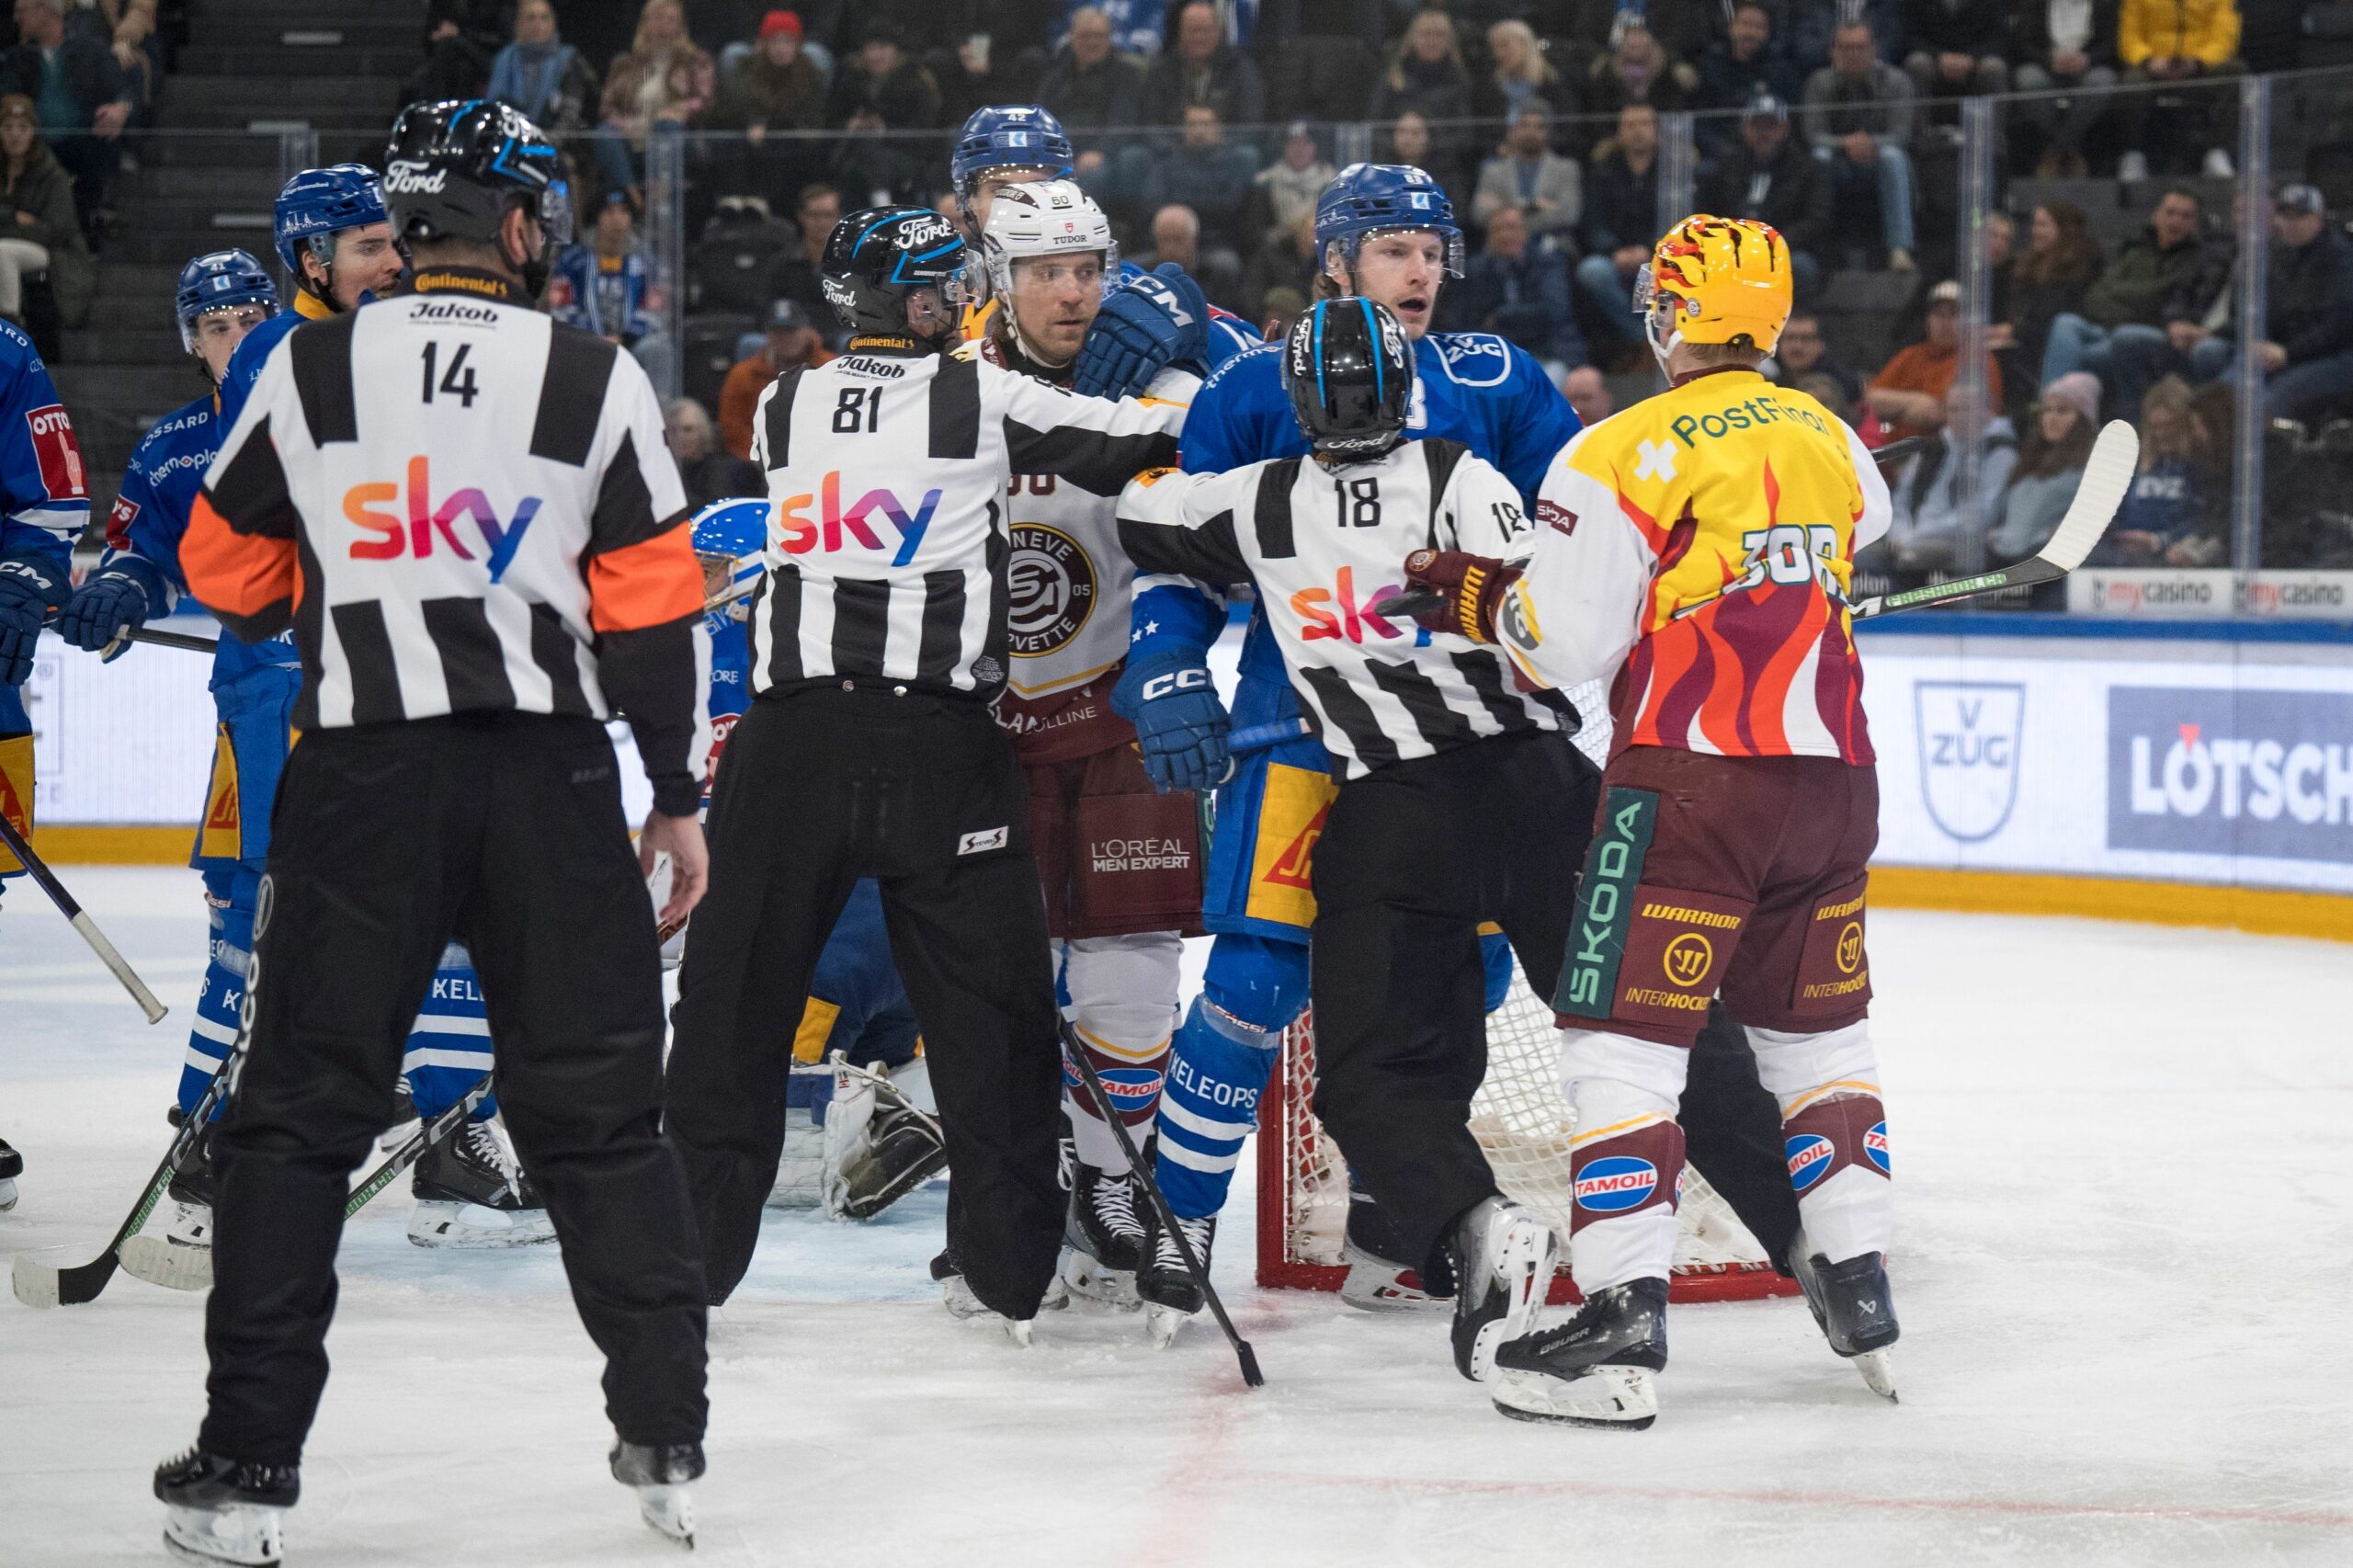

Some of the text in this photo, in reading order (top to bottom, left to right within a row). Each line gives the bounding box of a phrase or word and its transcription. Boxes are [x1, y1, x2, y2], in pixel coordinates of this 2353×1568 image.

[1007, 113, 1027, 122] 42
[383, 160, 448, 193] Ford
[1051, 195, 1070, 205] 60
[898, 215, 953, 250] Ford
[1052, 234, 1087, 244] TUDOR
[210, 263, 226, 271] 41
[415, 273, 497, 295] Continental
[823, 278, 857, 307] Ford
[410, 302, 498, 324] Jakob
[849, 336, 905, 350] Continental
[421, 341, 479, 407] 14
[837, 356, 905, 378] Jakob
[832, 386, 883, 433] 81
[1327, 433, 1388, 449] Ford
[1335, 477, 1381, 528] 18
[342, 455, 543, 585] sky
[779, 470, 944, 567] sky
[1013, 531, 1073, 562] NEVE
[1073, 585, 1091, 597] 05
[2109, 576, 2212, 611] mycasino
[1290, 565, 1432, 647] sk
[1957, 698, 1982, 730] V
[1931, 733, 2008, 768] ZUG
[1091, 837, 1190, 859] L'ORÉAL
[1093, 856, 1190, 872] MEN EXPERT
[1642, 903, 1741, 930] WARRIOR
[1168, 1052, 1258, 1109] KELEOPS
[1575, 1174, 1655, 1196] TAMOIL
[1540, 1326, 1590, 1356] BAUER
